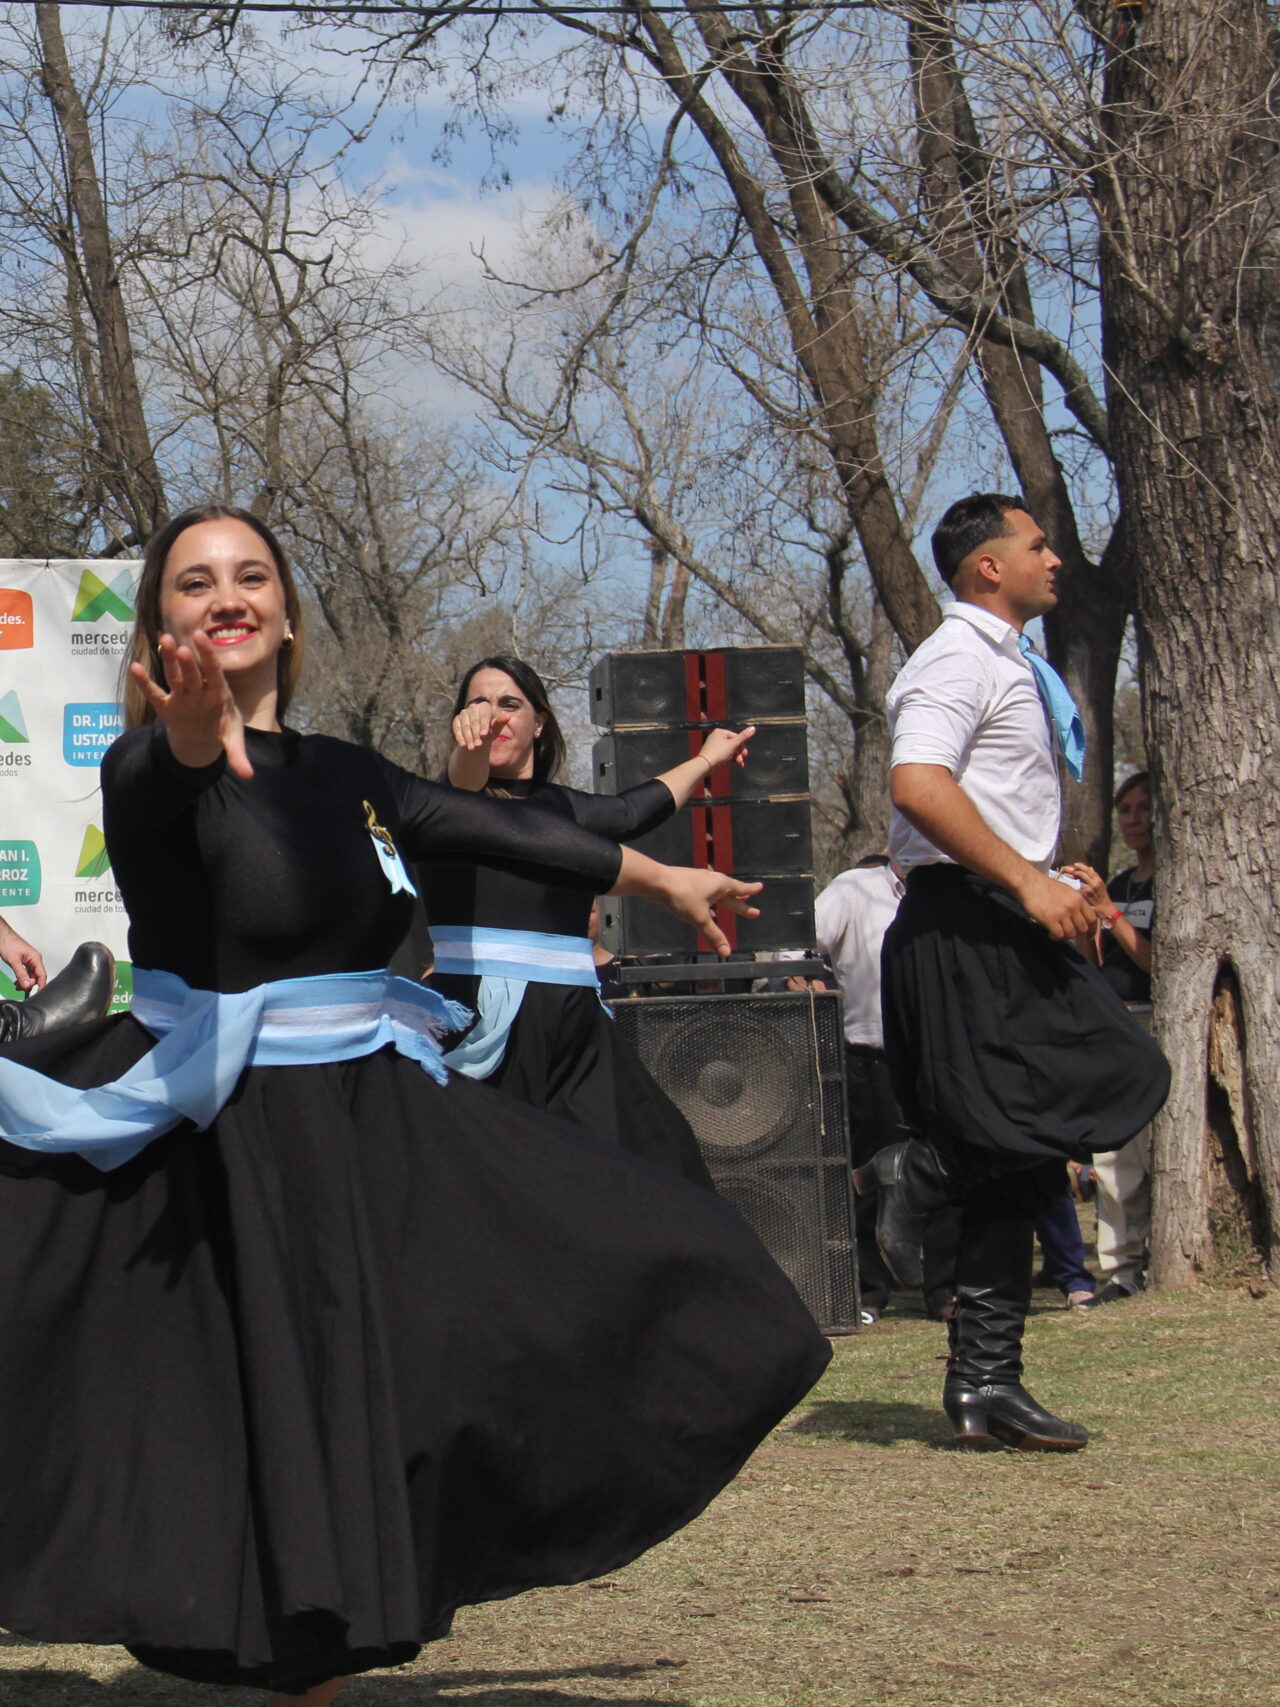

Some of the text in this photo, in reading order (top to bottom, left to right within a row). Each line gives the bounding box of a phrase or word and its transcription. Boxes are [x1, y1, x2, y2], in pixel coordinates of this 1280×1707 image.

[71, 629, 128, 645] merced
[71, 647, 98, 656] ciudad
[100, 647, 110, 656] de
[72, 714, 122, 729] DR. JUA
[72, 733, 121, 746] USTAR
[21, 849, 30, 862] I.
[74, 891, 122, 902] merce
[74, 905, 102, 913] ciudad
[103, 905, 113, 913] de
